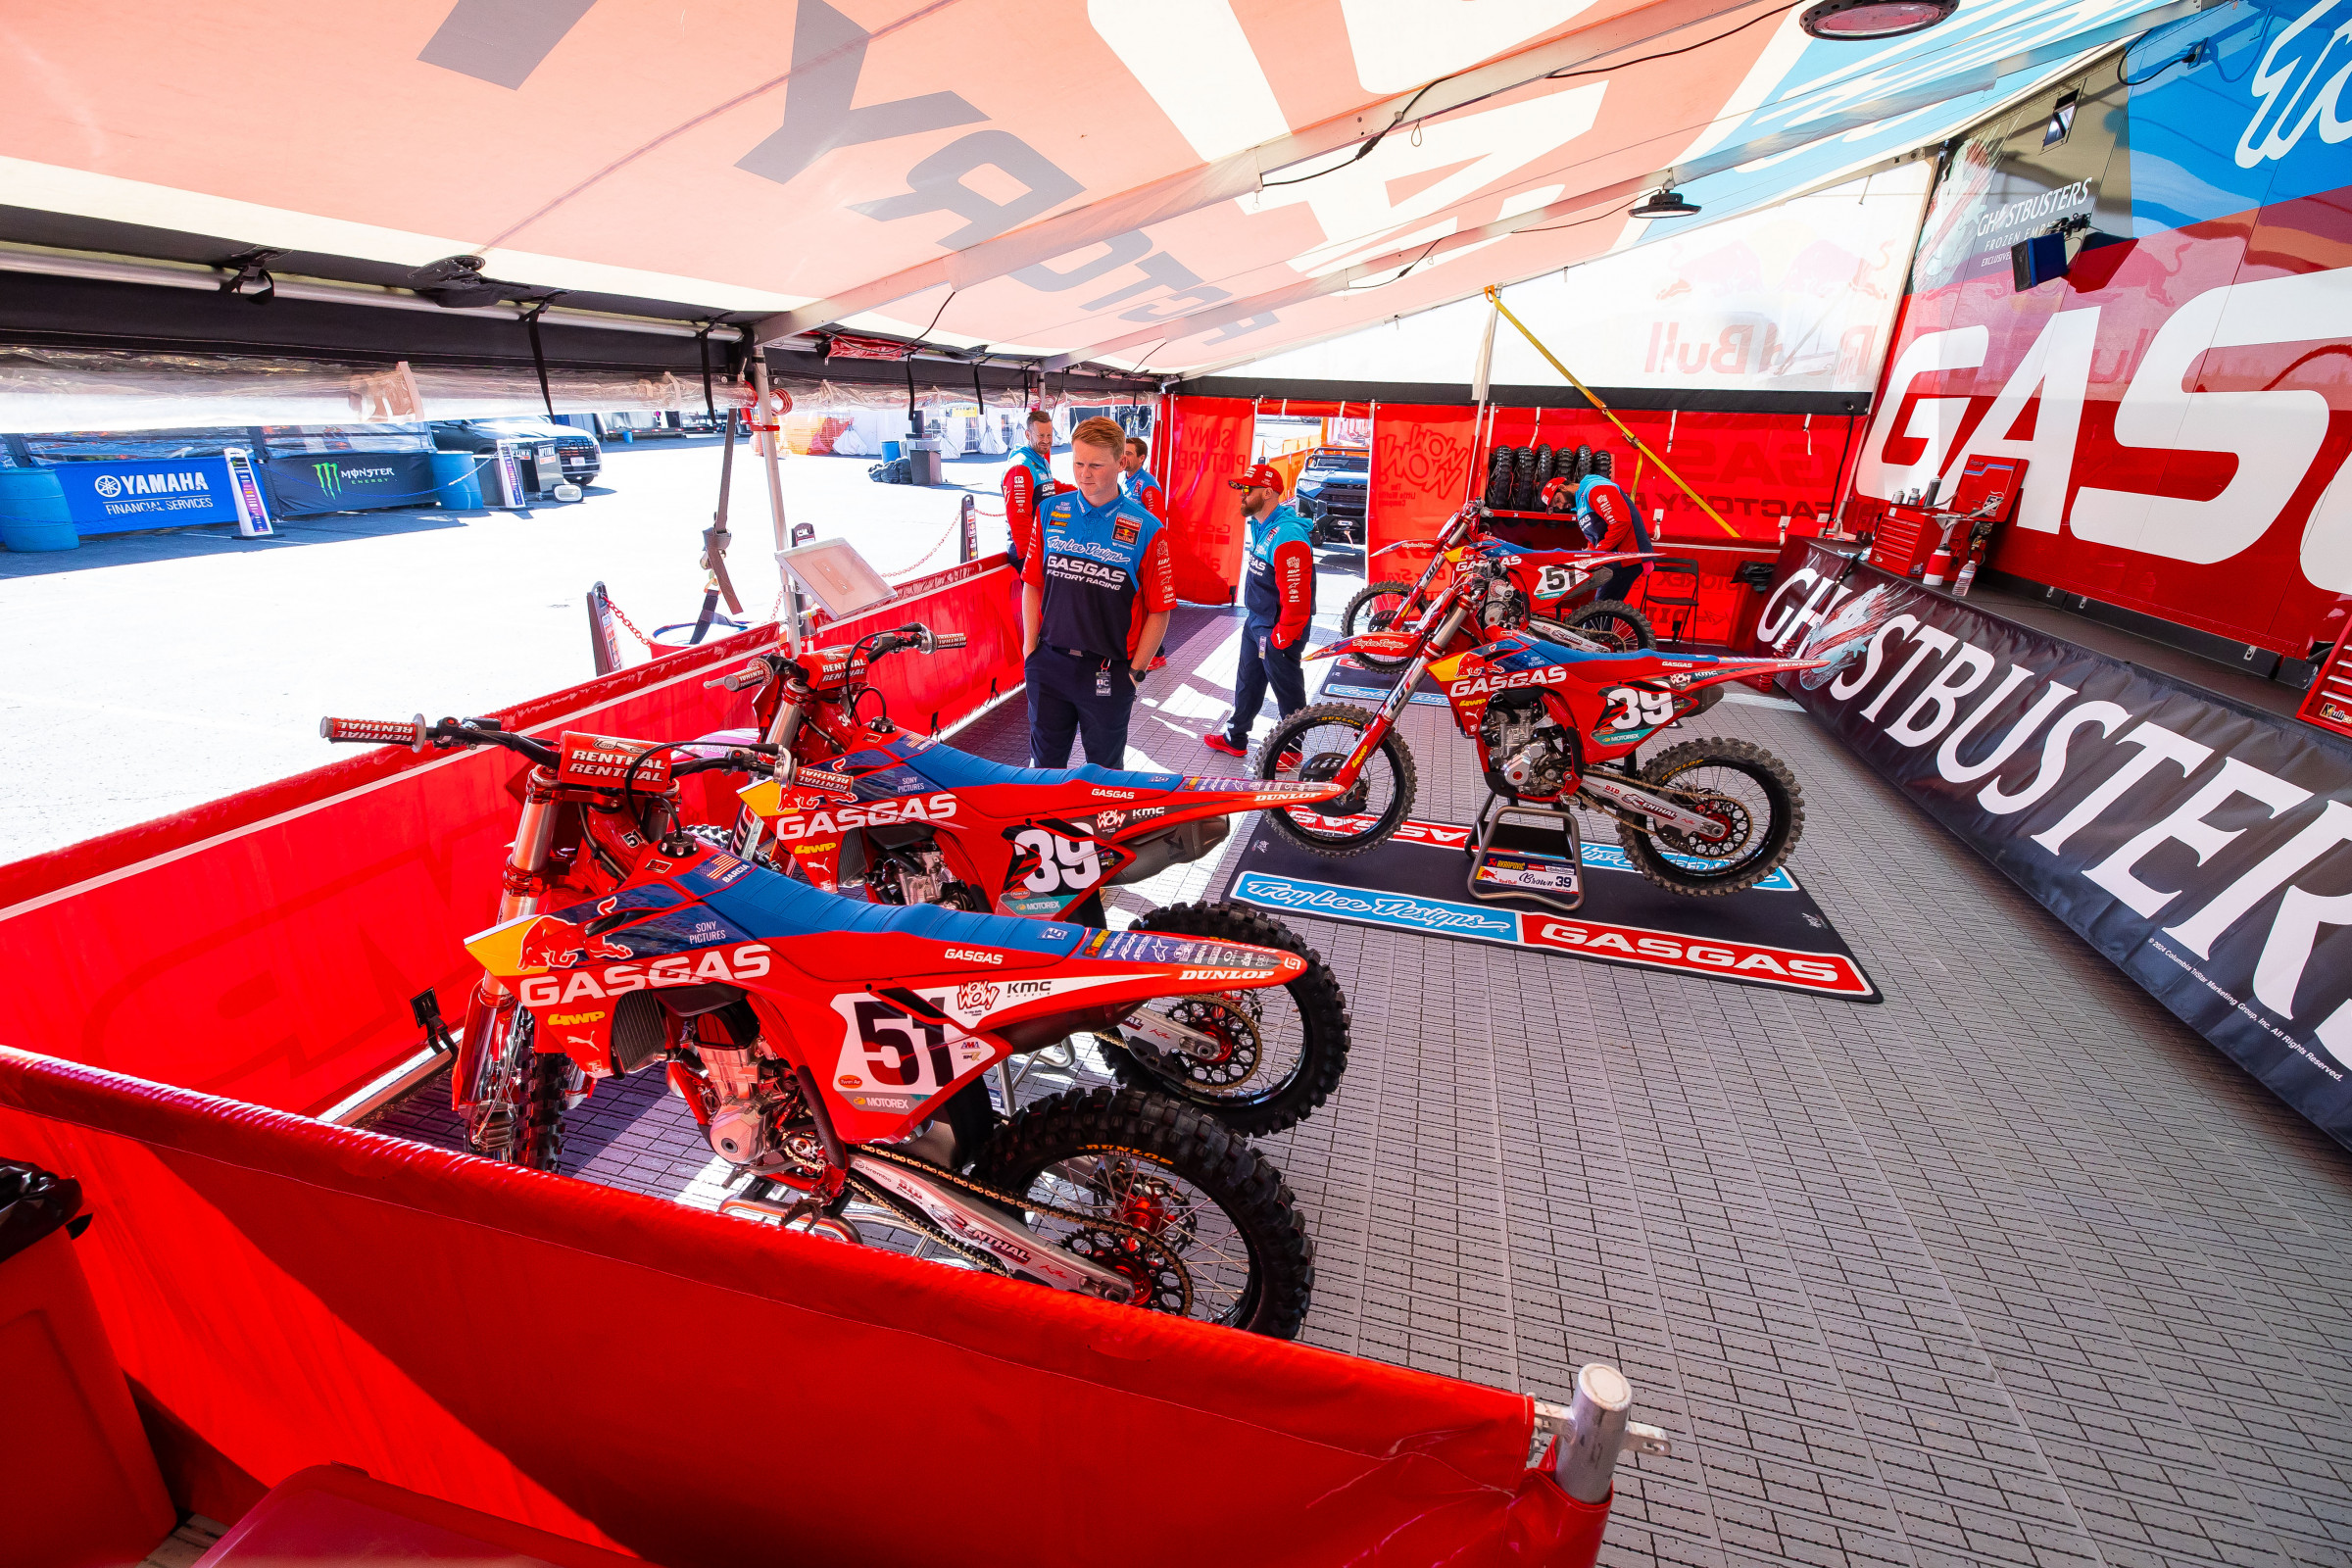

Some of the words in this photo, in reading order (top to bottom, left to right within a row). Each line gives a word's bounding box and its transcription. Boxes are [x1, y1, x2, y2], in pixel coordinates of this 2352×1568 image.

[1984, 233, 2020, 252] FROZEN
[120, 471, 210, 494] YAMAHA
[105, 501, 166, 515] FINANCIAL
[167, 497, 214, 511] SERVICES
[1047, 535, 1067, 552] Troy
[1065, 538, 1086, 553] Lee
[1086, 542, 1131, 564] Designs
[1047, 555, 1127, 583] GASGAS
[1545, 565, 1578, 590] 51
[1046, 568, 1086, 583] FACTORY
[1085, 577, 1122, 591] RACING
[1450, 665, 1568, 698] GASGAS
[1607, 680, 1674, 730] 39
[1320, 715, 1361, 727] DUNLOP
[1610, 732, 1641, 742] MOTOREX
[897, 782, 925, 794] PICTURES
[902, 776, 917, 785] SONY
[1091, 787, 1135, 800] GASGAS
[1253, 792, 1322, 802] DUNLOP
[776, 793, 956, 841] GASGAS
[1132, 806, 1165, 817] KMC
[794, 841, 837, 855] 4WP
[1014, 822, 1101, 893] 39
[722, 863, 751, 884] BARCIA
[1519, 872, 1554, 887] Brown
[1555, 876, 1572, 888] 39
[1026, 900, 1060, 910] MOTOREX
[1247, 881, 1311, 906] Troy
[1310, 890, 1372, 911] Lee
[1372, 898, 1511, 928] Designs
[695, 921, 717, 933] SONY
[689, 929, 726, 945] PICTURES
[944, 948, 1004, 965] GASGAS
[1541, 922, 1838, 983] GASGAS
[519, 944, 772, 1007] GASGAS
[1179, 969, 1275, 980] DUNLOP
[959, 980, 988, 996] WOW
[1006, 981, 1053, 995] KMC
[957, 986, 1000, 1010] WOW!
[547, 1010, 606, 1026] 4WP
[2152, 941, 2167, 953] 2024
[2164, 950, 2193, 972] Columbia
[2190, 967, 2209, 983] TriStar
[2205, 980, 2239, 1006] Marketing
[2237, 1003, 2258, 1021] Group,
[2257, 1017, 2271, 1031] Inc.
[2270, 1027, 2284, 1038] All
[2281, 1035, 2307, 1055] Rights
[2305, 1052, 2344, 1082] Reserved.
[854, 997, 955, 1087] 51
[865, 1097, 909, 1108] MOTOREX
[1085, 1144, 1174, 1165] DUNLOP
[864, 1165, 892, 1183] brembo
